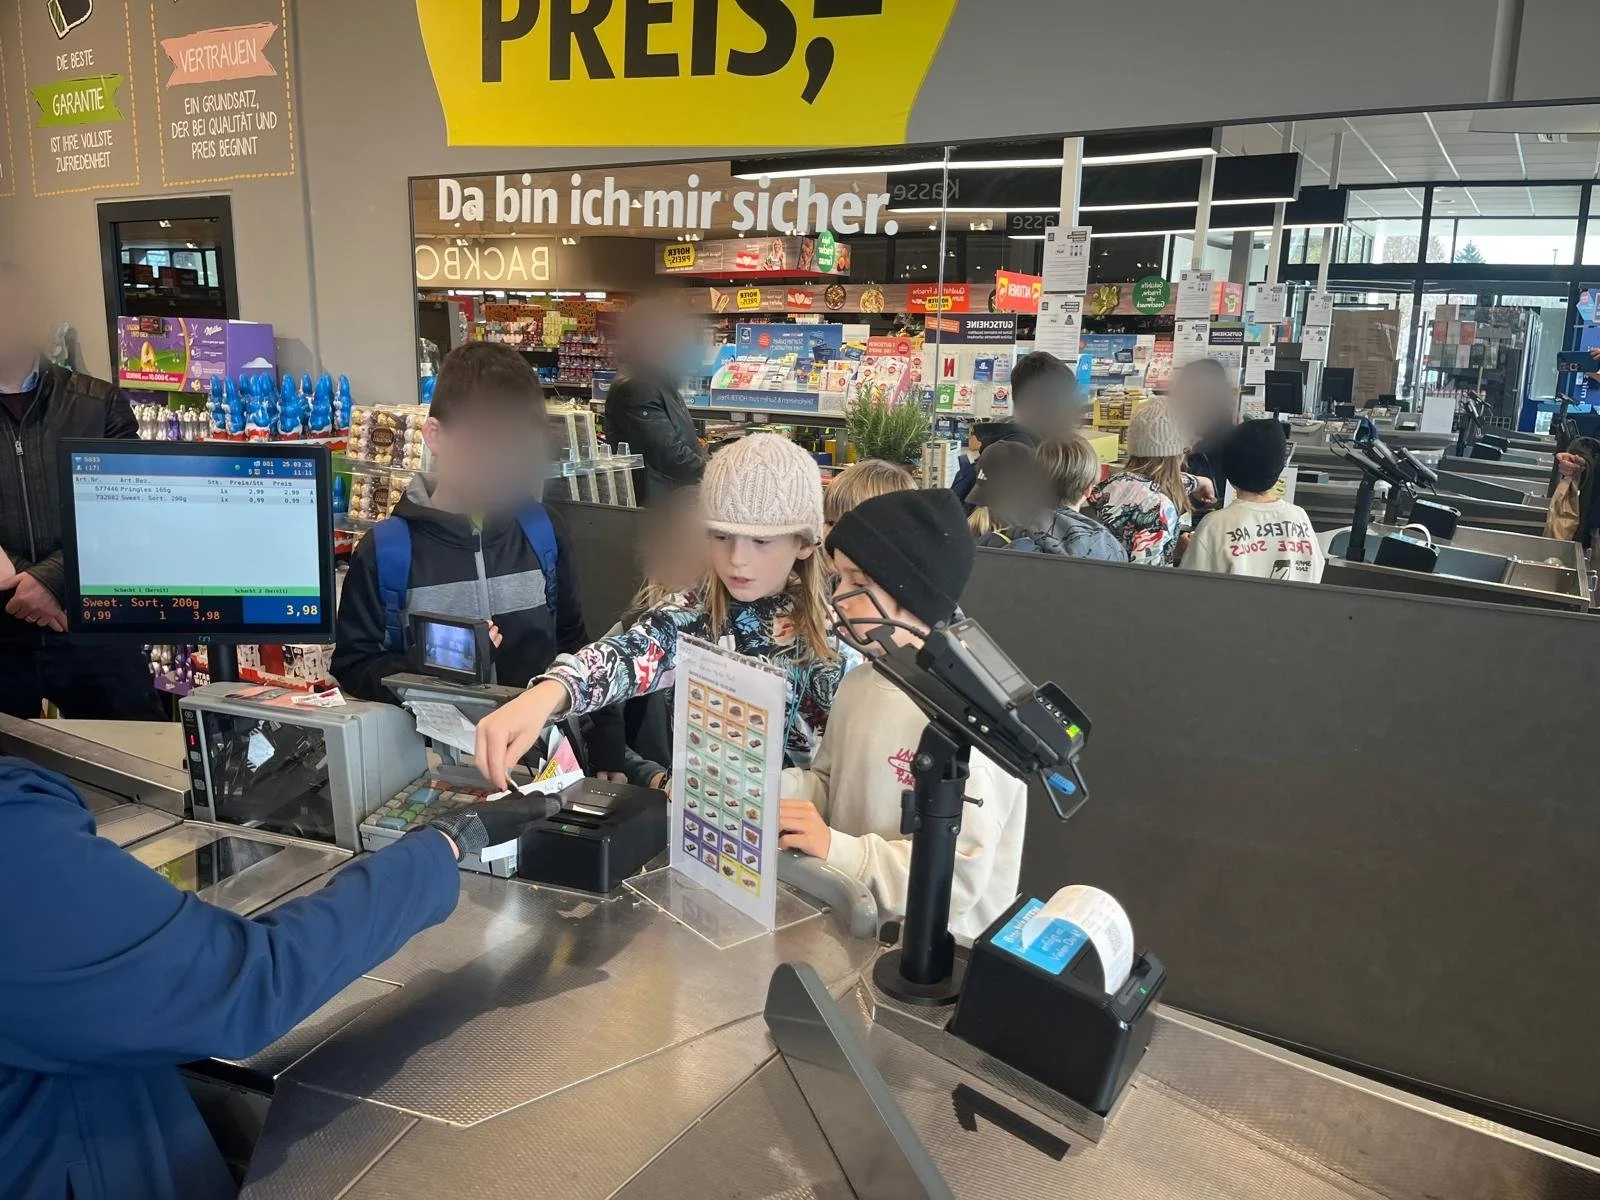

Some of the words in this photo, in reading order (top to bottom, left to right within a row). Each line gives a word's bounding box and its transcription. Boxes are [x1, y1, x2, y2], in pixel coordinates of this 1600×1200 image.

[56, 54, 69, 71] DIE
[70, 49, 95, 69] BESTE
[179, 38, 257, 73] VERTRAUEN
[52, 87, 104, 116] GARANTIE
[184, 96, 200, 115] EIN
[202, 90, 259, 112] GRUNDSATZ,
[171, 120, 190, 139] DER
[192, 118, 206, 137] BEI
[208, 112, 253, 136] QUALITÄT
[255, 111, 278, 130] UND
[50, 136, 61, 153] IST
[62, 134, 79, 151] IHRE
[80, 130, 113, 149] VOLLSTE
[191, 141, 216, 160] PREIS
[219, 136, 258, 158] BEGINNT
[55, 151, 111, 173] ZUFRIEDENHEIT
[438, 179, 484, 222] Da
[496, 173, 558, 224] bin
[570, 173, 630, 227] ich
[643, 174, 721, 230] mir
[732, 175, 899, 236] sicher.
[204, 325, 222, 336] Milka
[83, 598, 123, 608] Sweet.
[131, 598, 164, 608] Sort.
[172, 598, 200, 610] 200g
[286, 605, 318, 617] 3,98
[84, 611, 111, 621] 0,99
[159, 611, 166, 620] 1
[193, 611, 220, 621] 3,98
